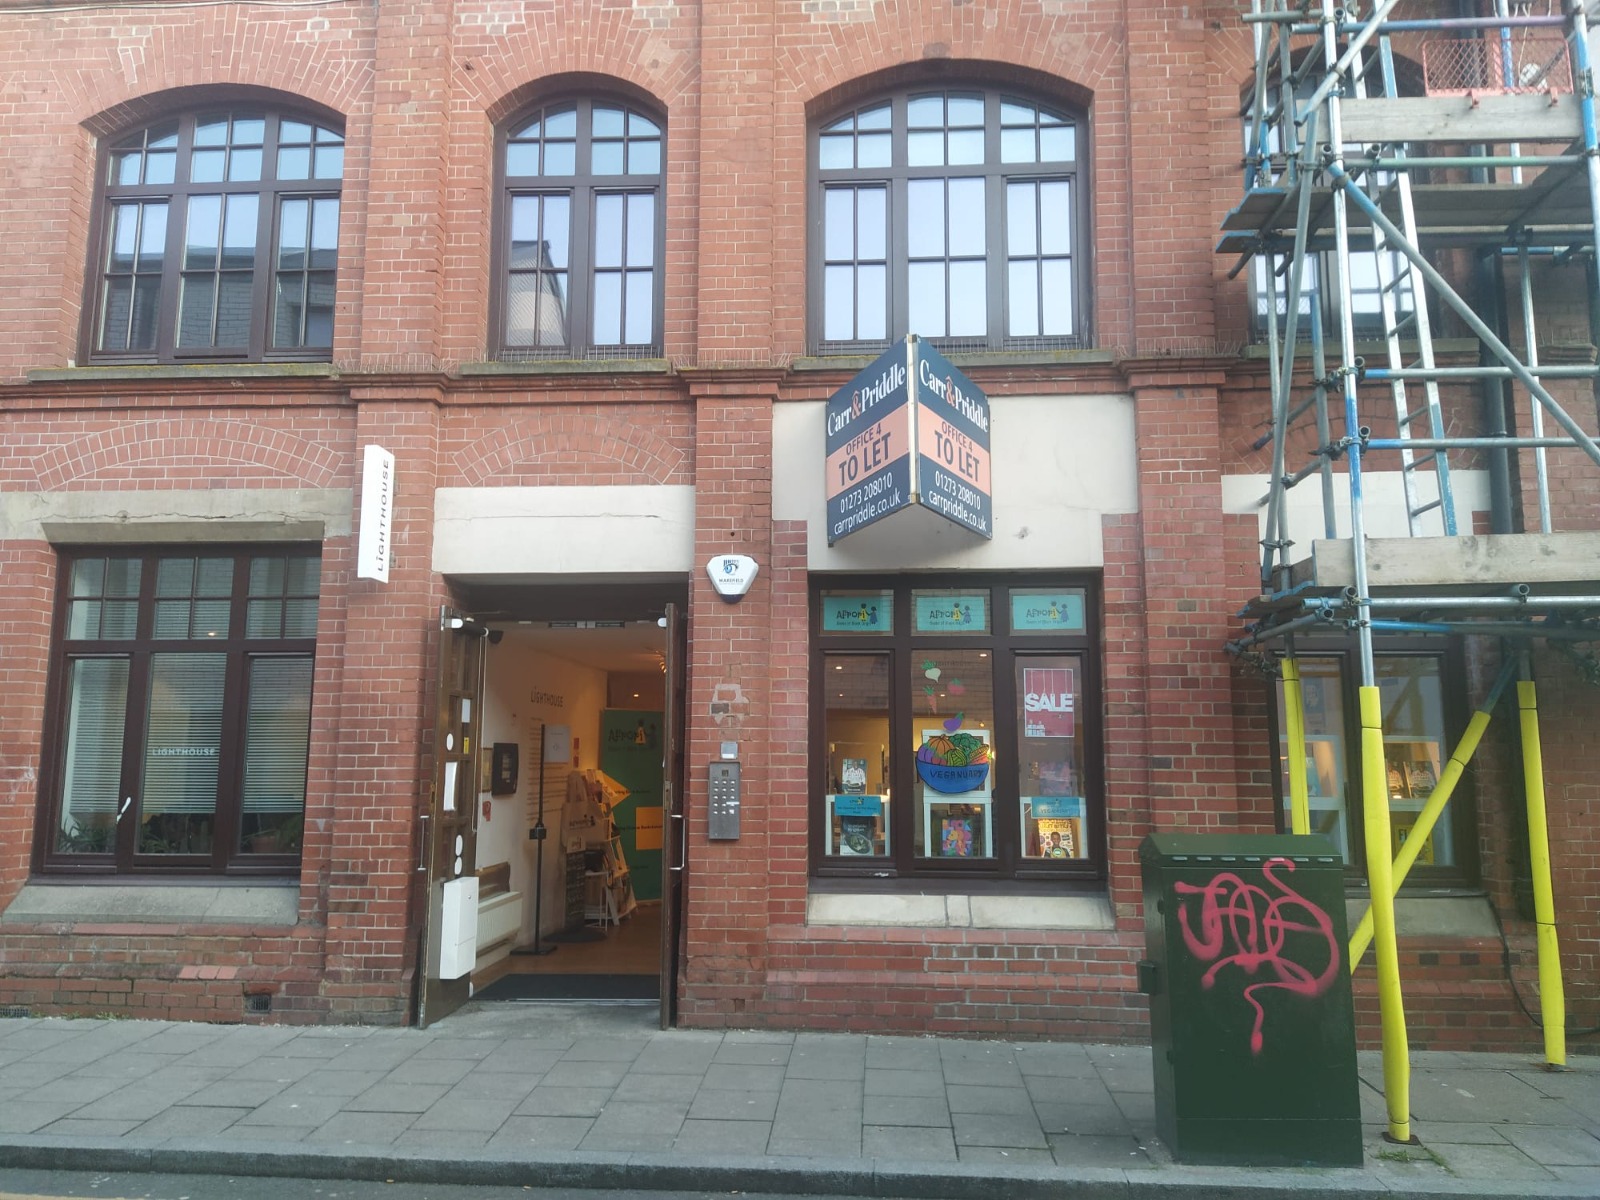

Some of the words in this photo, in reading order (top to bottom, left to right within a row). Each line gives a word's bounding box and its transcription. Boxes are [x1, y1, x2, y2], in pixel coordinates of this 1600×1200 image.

[846, 428, 874, 455] OFFICE
[875, 423, 882, 436] 4
[934, 430, 954, 465] TO
[958, 444, 980, 482] LET
[941, 421, 967, 446] OFFICE
[968, 440, 973, 452] 4
[839, 454, 859, 486] TO
[863, 432, 891, 473] LET
[840, 489, 862, 513] 01273
[864, 472, 893, 501] 208010
[928, 489, 987, 531] carrpriddle.co.uk
[935, 471, 957, 495] 01273
[958, 483, 981, 510] 208010
[376, 460, 388, 571] LIGHTHOUSE
[834, 488, 901, 535] carrpriddle.co.uk
[1025, 693, 1073, 712] SALE
[152, 748, 215, 756] LIGHTHOUSE
